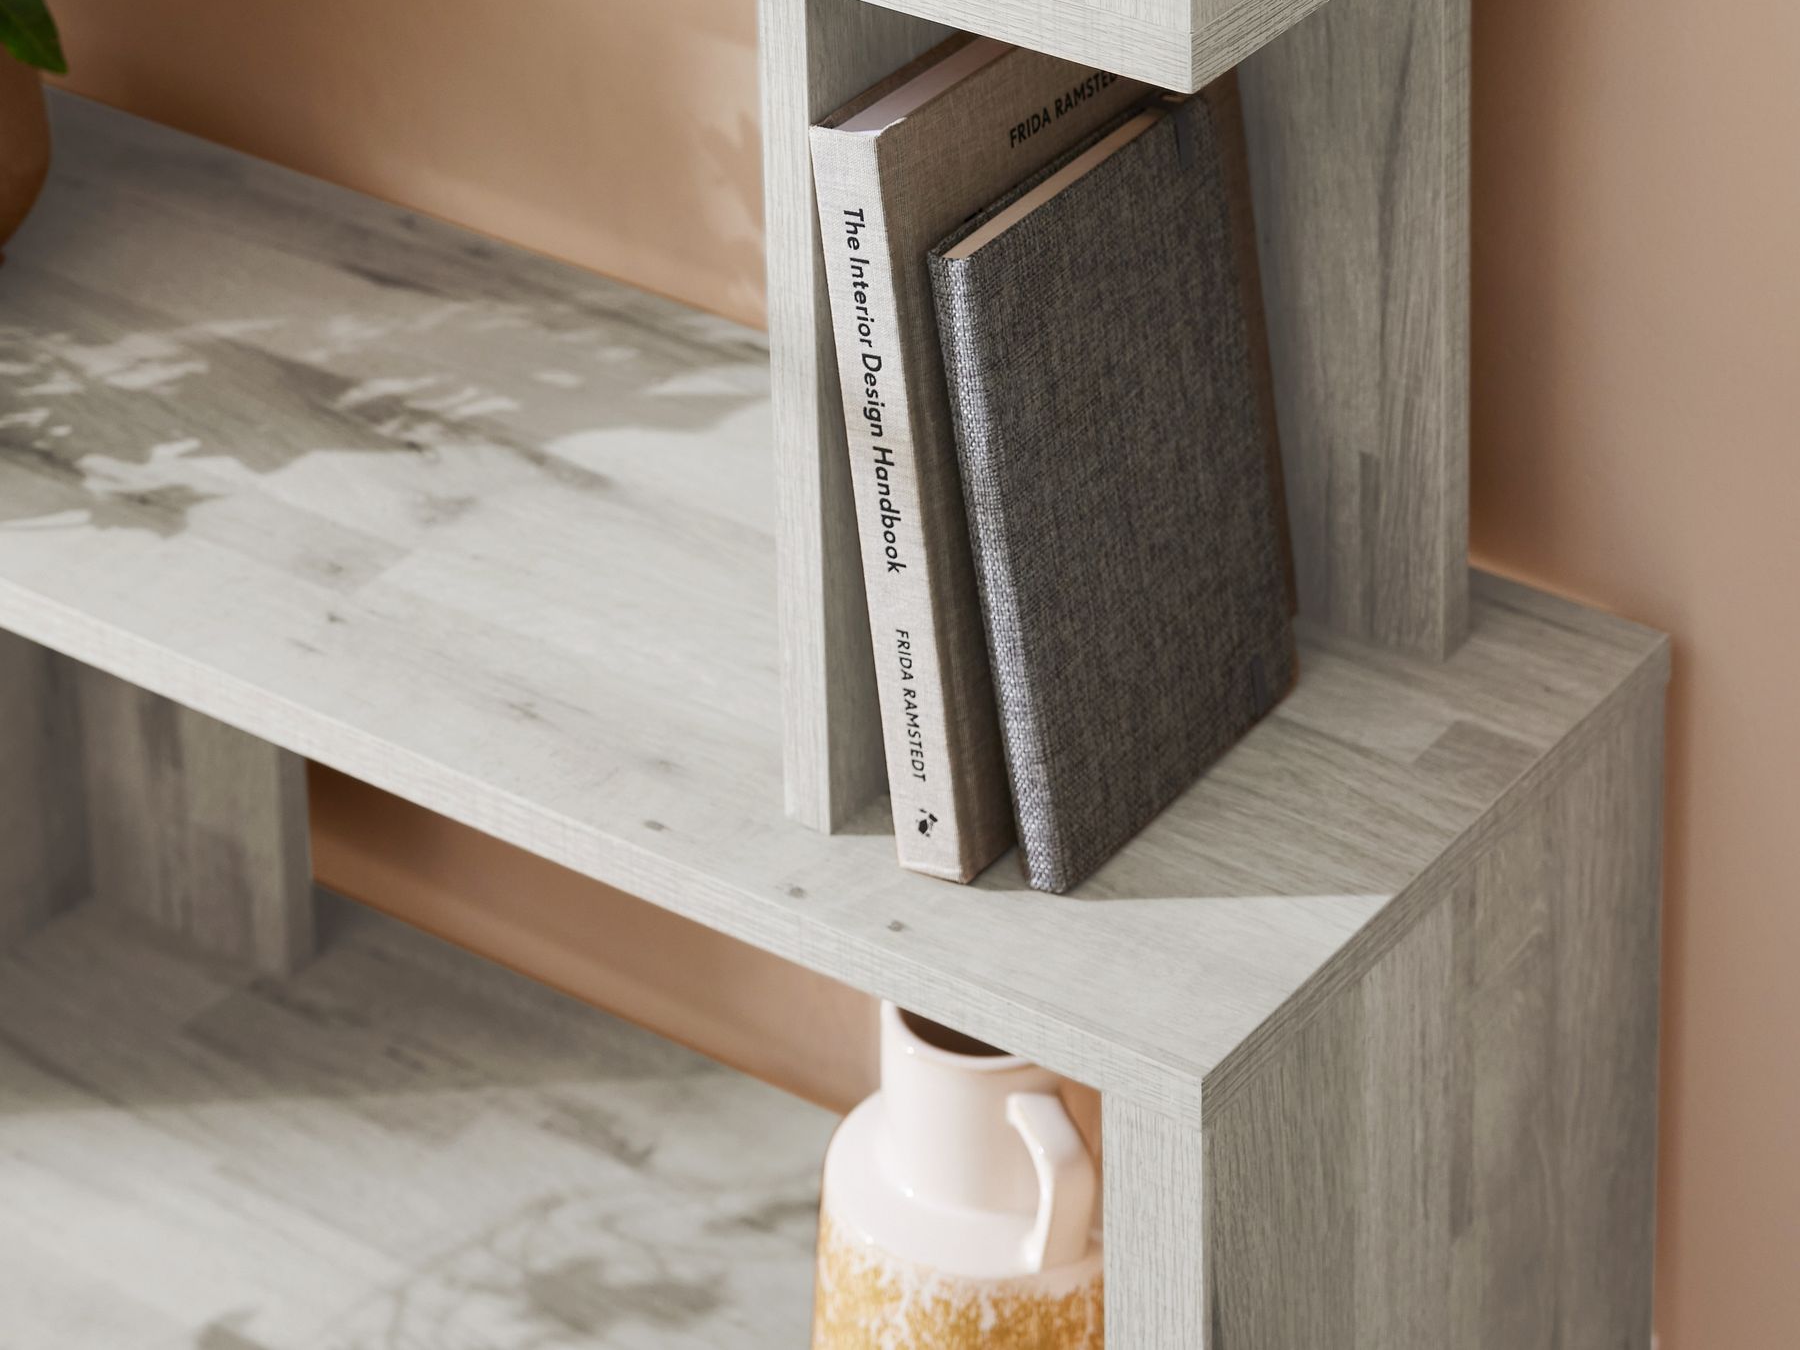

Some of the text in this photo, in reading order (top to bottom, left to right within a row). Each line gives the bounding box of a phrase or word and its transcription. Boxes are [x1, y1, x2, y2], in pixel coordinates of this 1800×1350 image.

[1008, 108, 1052, 149] FRIDA
[843, 208, 907, 573] The Interior Design Handbook
[896, 628, 926, 782] FRIDA RAMSTEDT
